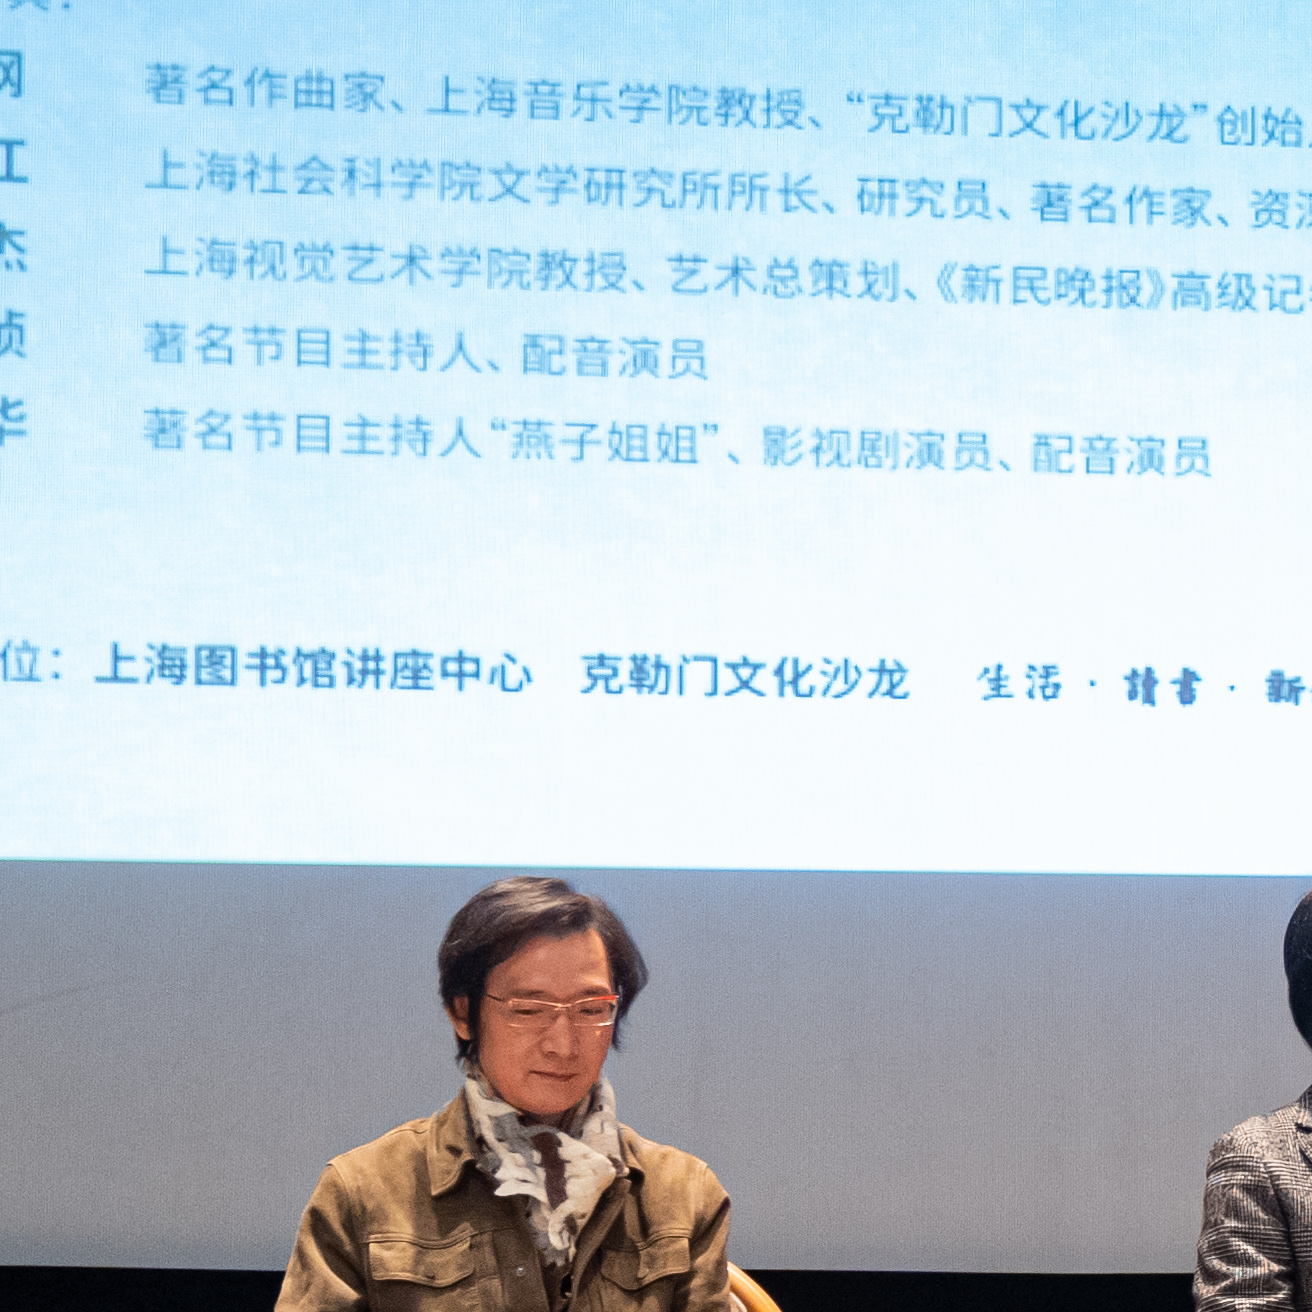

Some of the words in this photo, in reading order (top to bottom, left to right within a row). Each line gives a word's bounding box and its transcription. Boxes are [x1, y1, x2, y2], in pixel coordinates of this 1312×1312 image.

[144, 320, 708, 382] 著名节目主持人、配音演员
[580, 651, 911, 700] 克勒门文化沙龙
